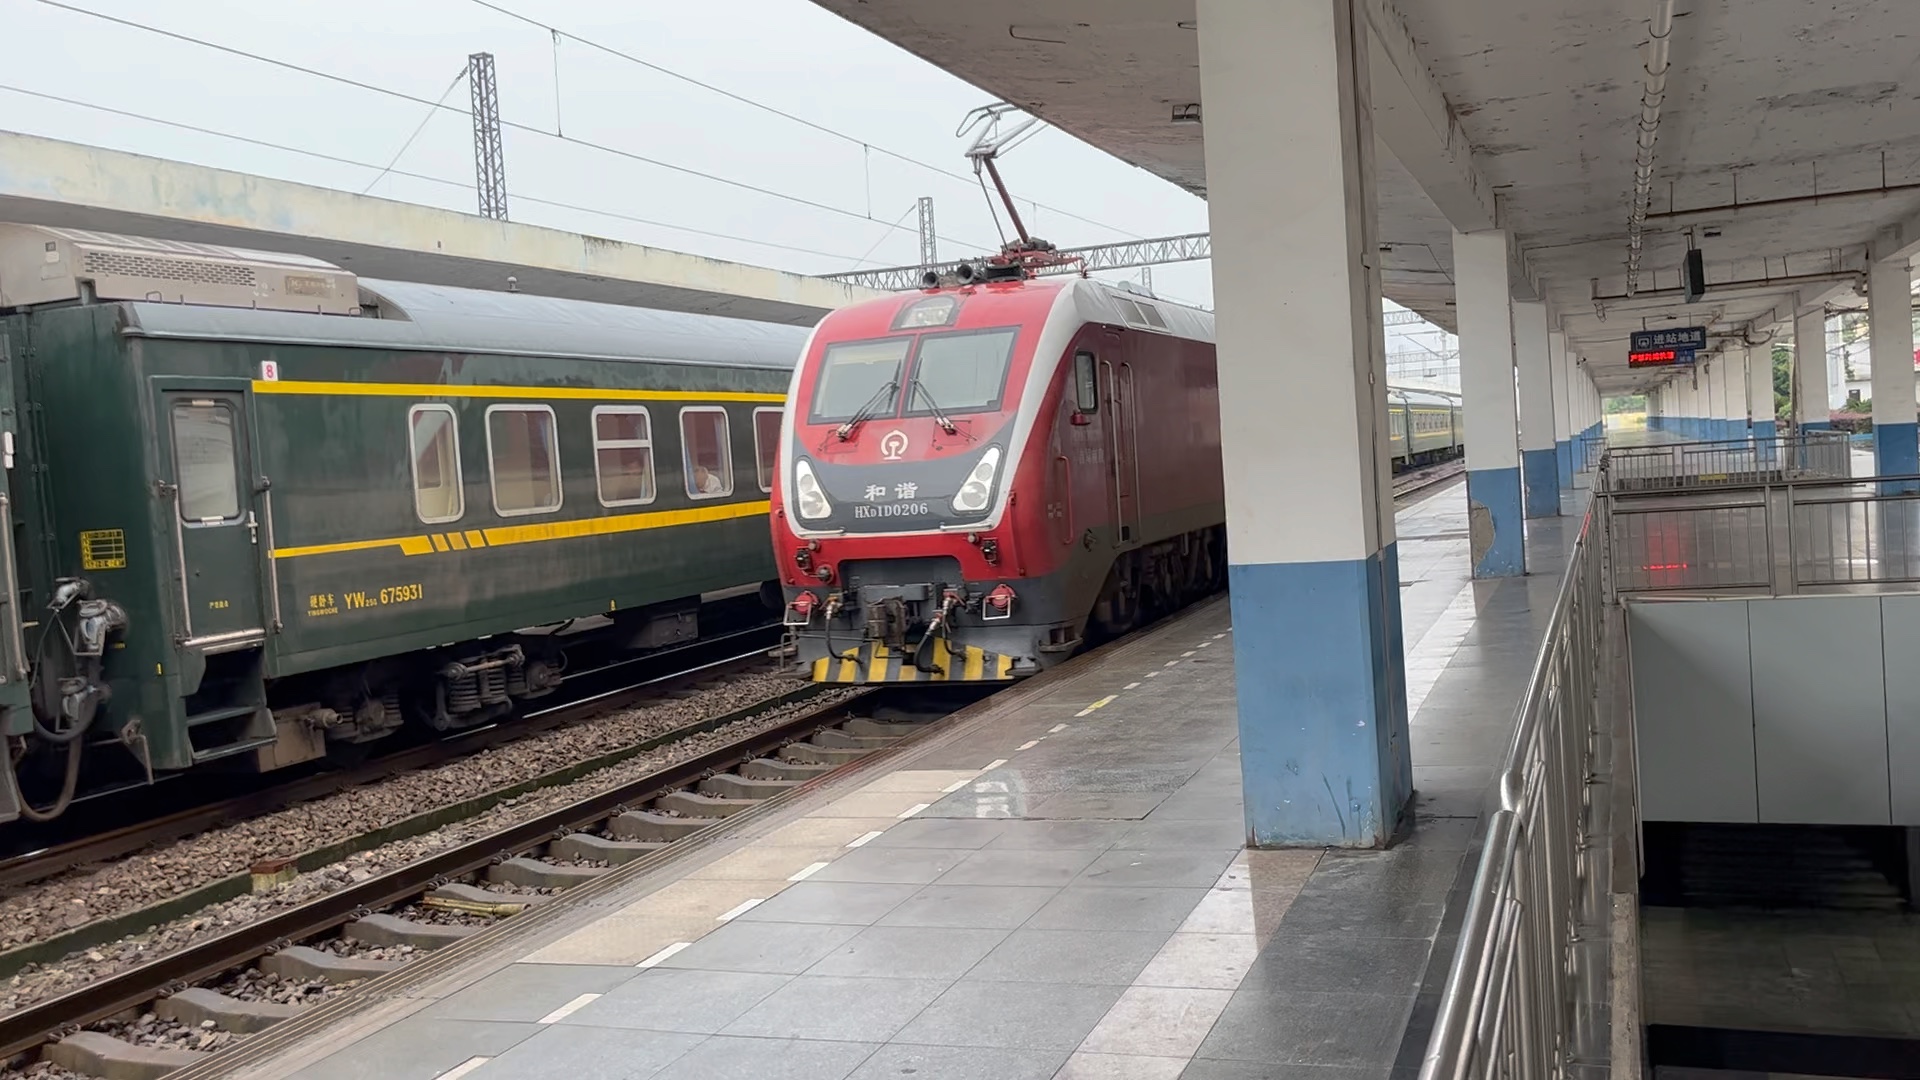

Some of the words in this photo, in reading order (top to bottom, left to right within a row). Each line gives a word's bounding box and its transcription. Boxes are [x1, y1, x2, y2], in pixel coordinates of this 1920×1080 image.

[1653, 331, 1701, 345] 进站地道
[266, 364, 273, 378] 8
[864, 481, 918, 501] 和谐
[380, 583, 423, 605] 675931
